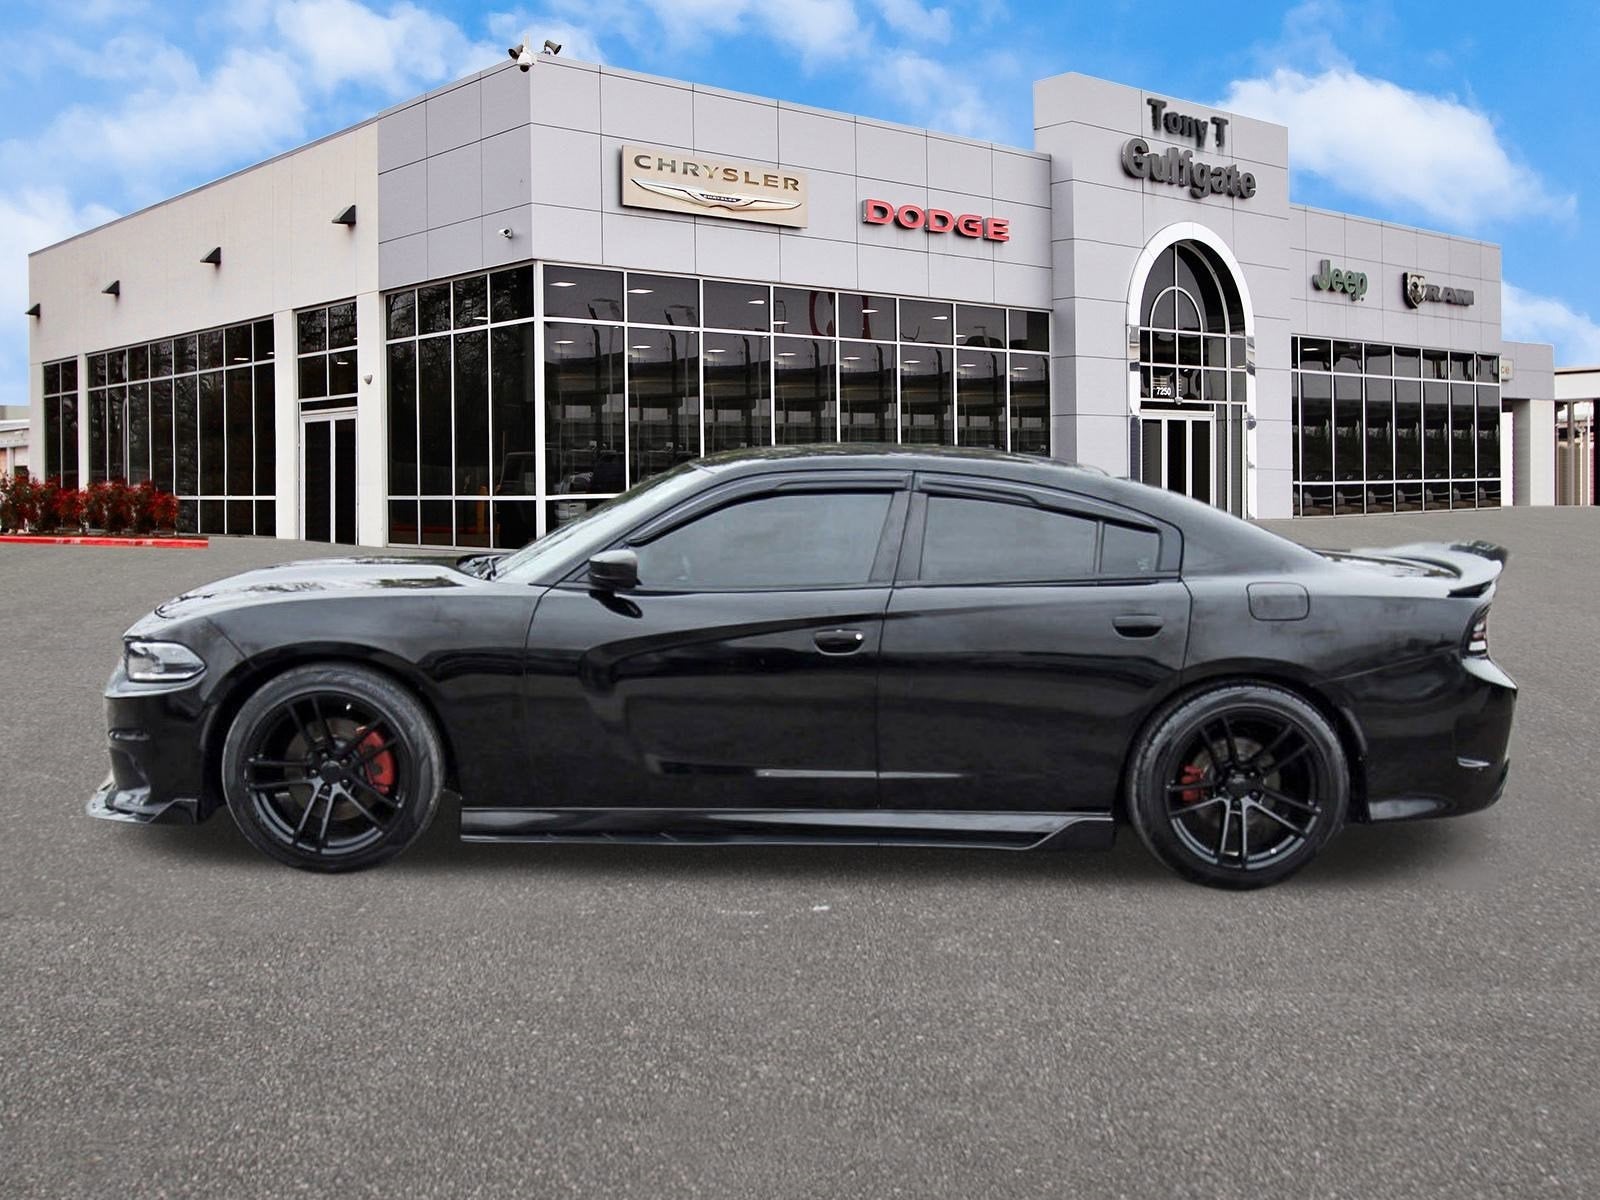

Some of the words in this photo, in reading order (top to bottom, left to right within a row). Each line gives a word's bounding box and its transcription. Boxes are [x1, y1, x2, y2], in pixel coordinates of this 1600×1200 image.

[1147, 98, 1208, 148] Tony
[1211, 116, 1229, 147] T
[633, 154, 800, 192] CHRYSLER
[1121, 138, 1257, 199] Gulfgate
[863, 198, 1011, 242] DODGE
[1312, 259, 1368, 302] Jeep
[1425, 284, 1475, 307] RAM
[1156, 387, 1172, 396] 7250
